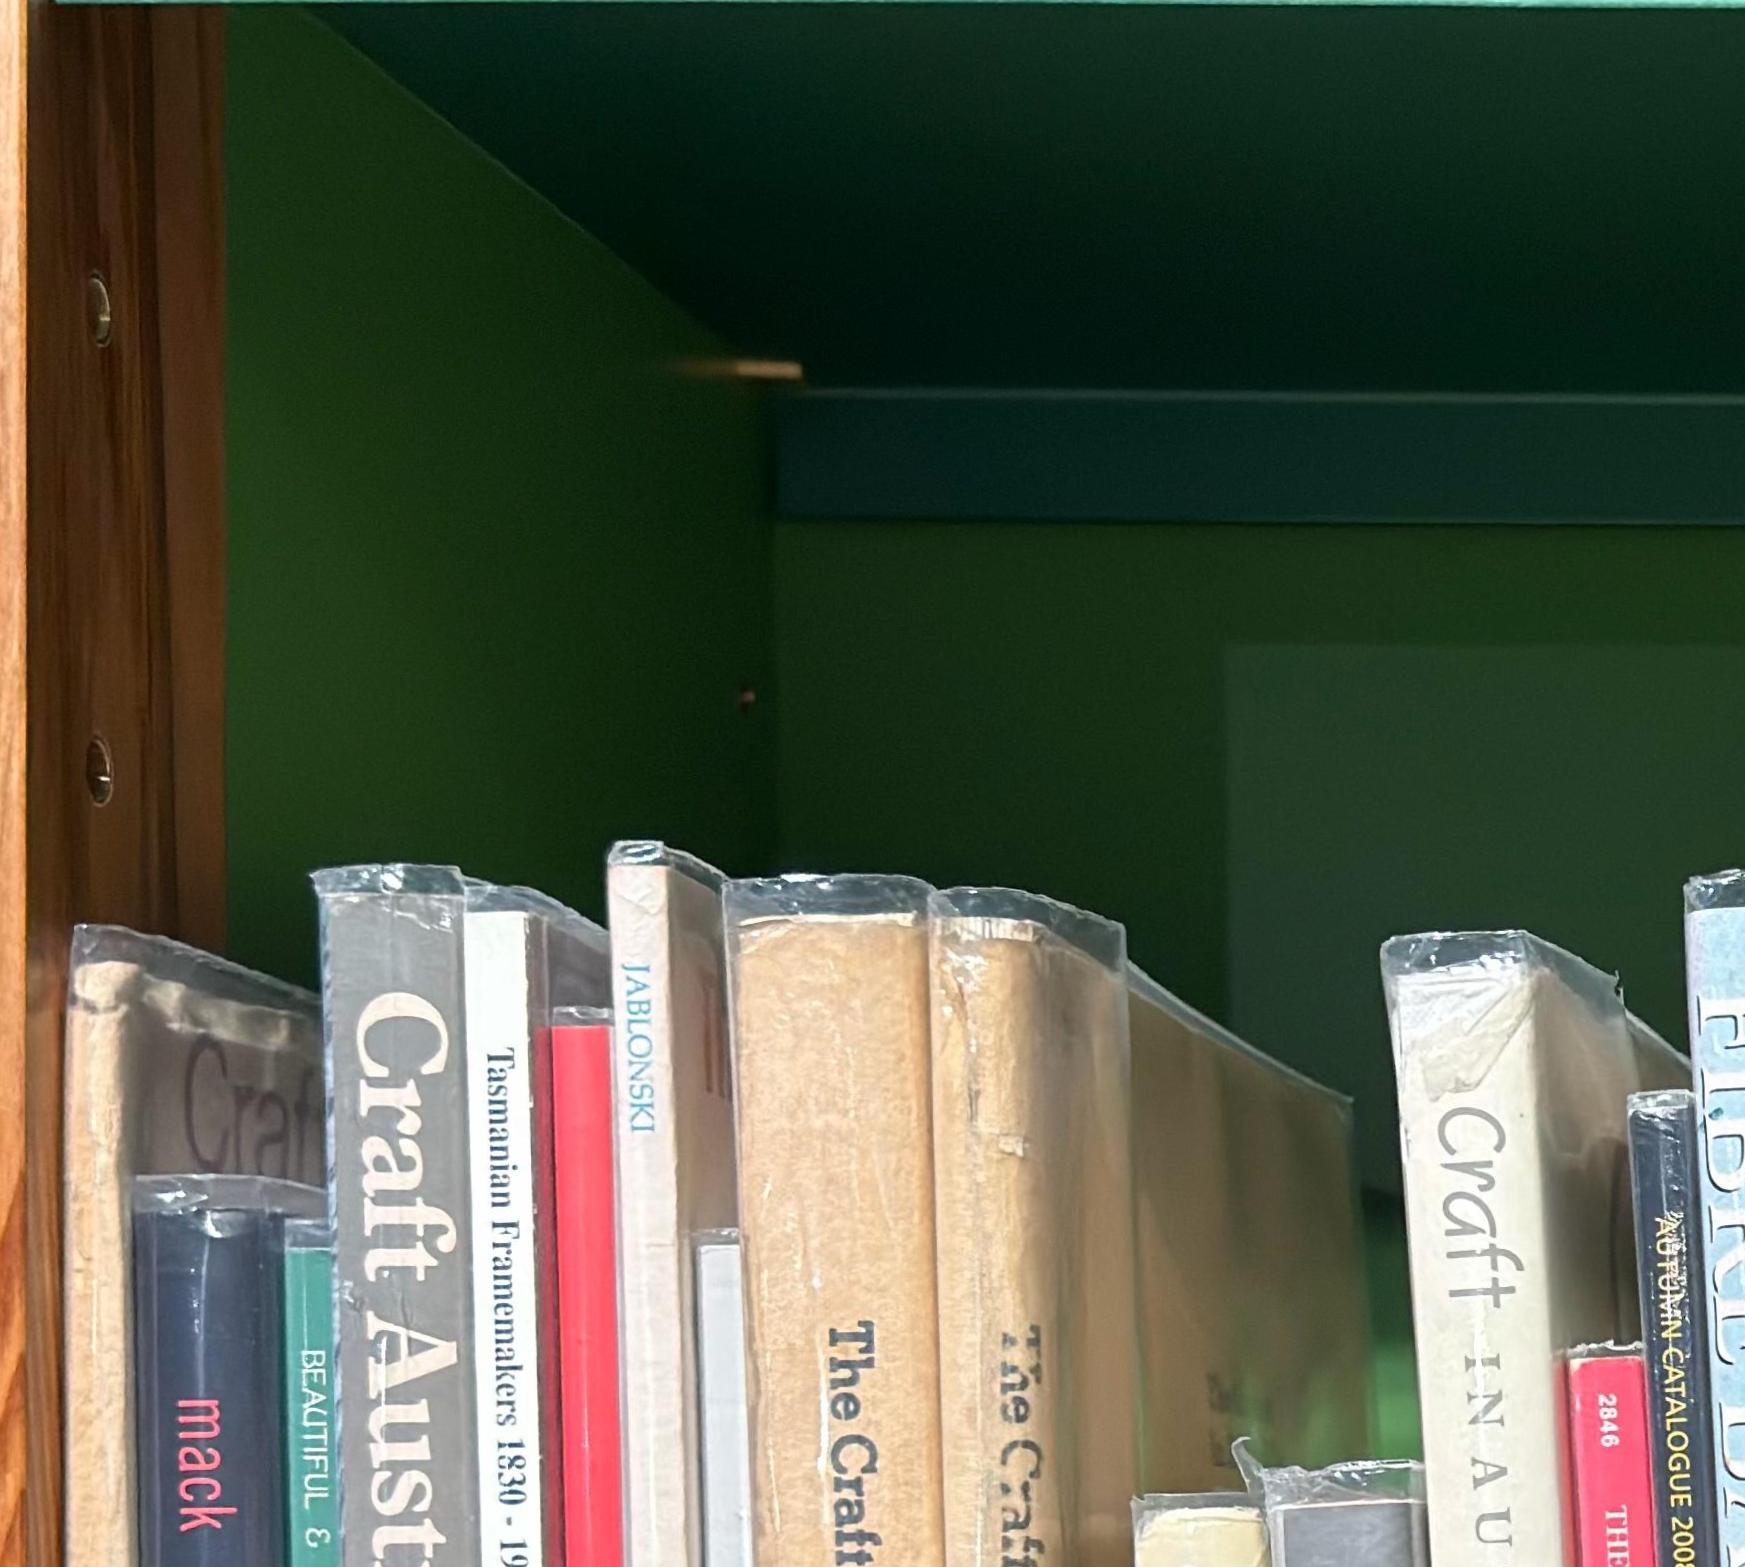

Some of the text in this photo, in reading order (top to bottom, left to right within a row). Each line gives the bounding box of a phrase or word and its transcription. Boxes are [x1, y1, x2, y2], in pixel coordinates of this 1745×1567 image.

[486, 1046, 518, 1209] Tasmanian
[620, 963, 658, 1134] JABLONSKI
[355, 991, 458, 1283] Craft
[1436, 1106, 1526, 1309] Craft
[491, 1219, 525, 1429] Framemakers
[177, 1399, 238, 1532] mack
[300, 1349, 330, 1510] BEAUTIFUL
[497, 1440, 525, 1507] 1830
[1597, 1393, 1621, 1449] 2846
[1660, 1347, 1694, 1508] CATALOGUE
